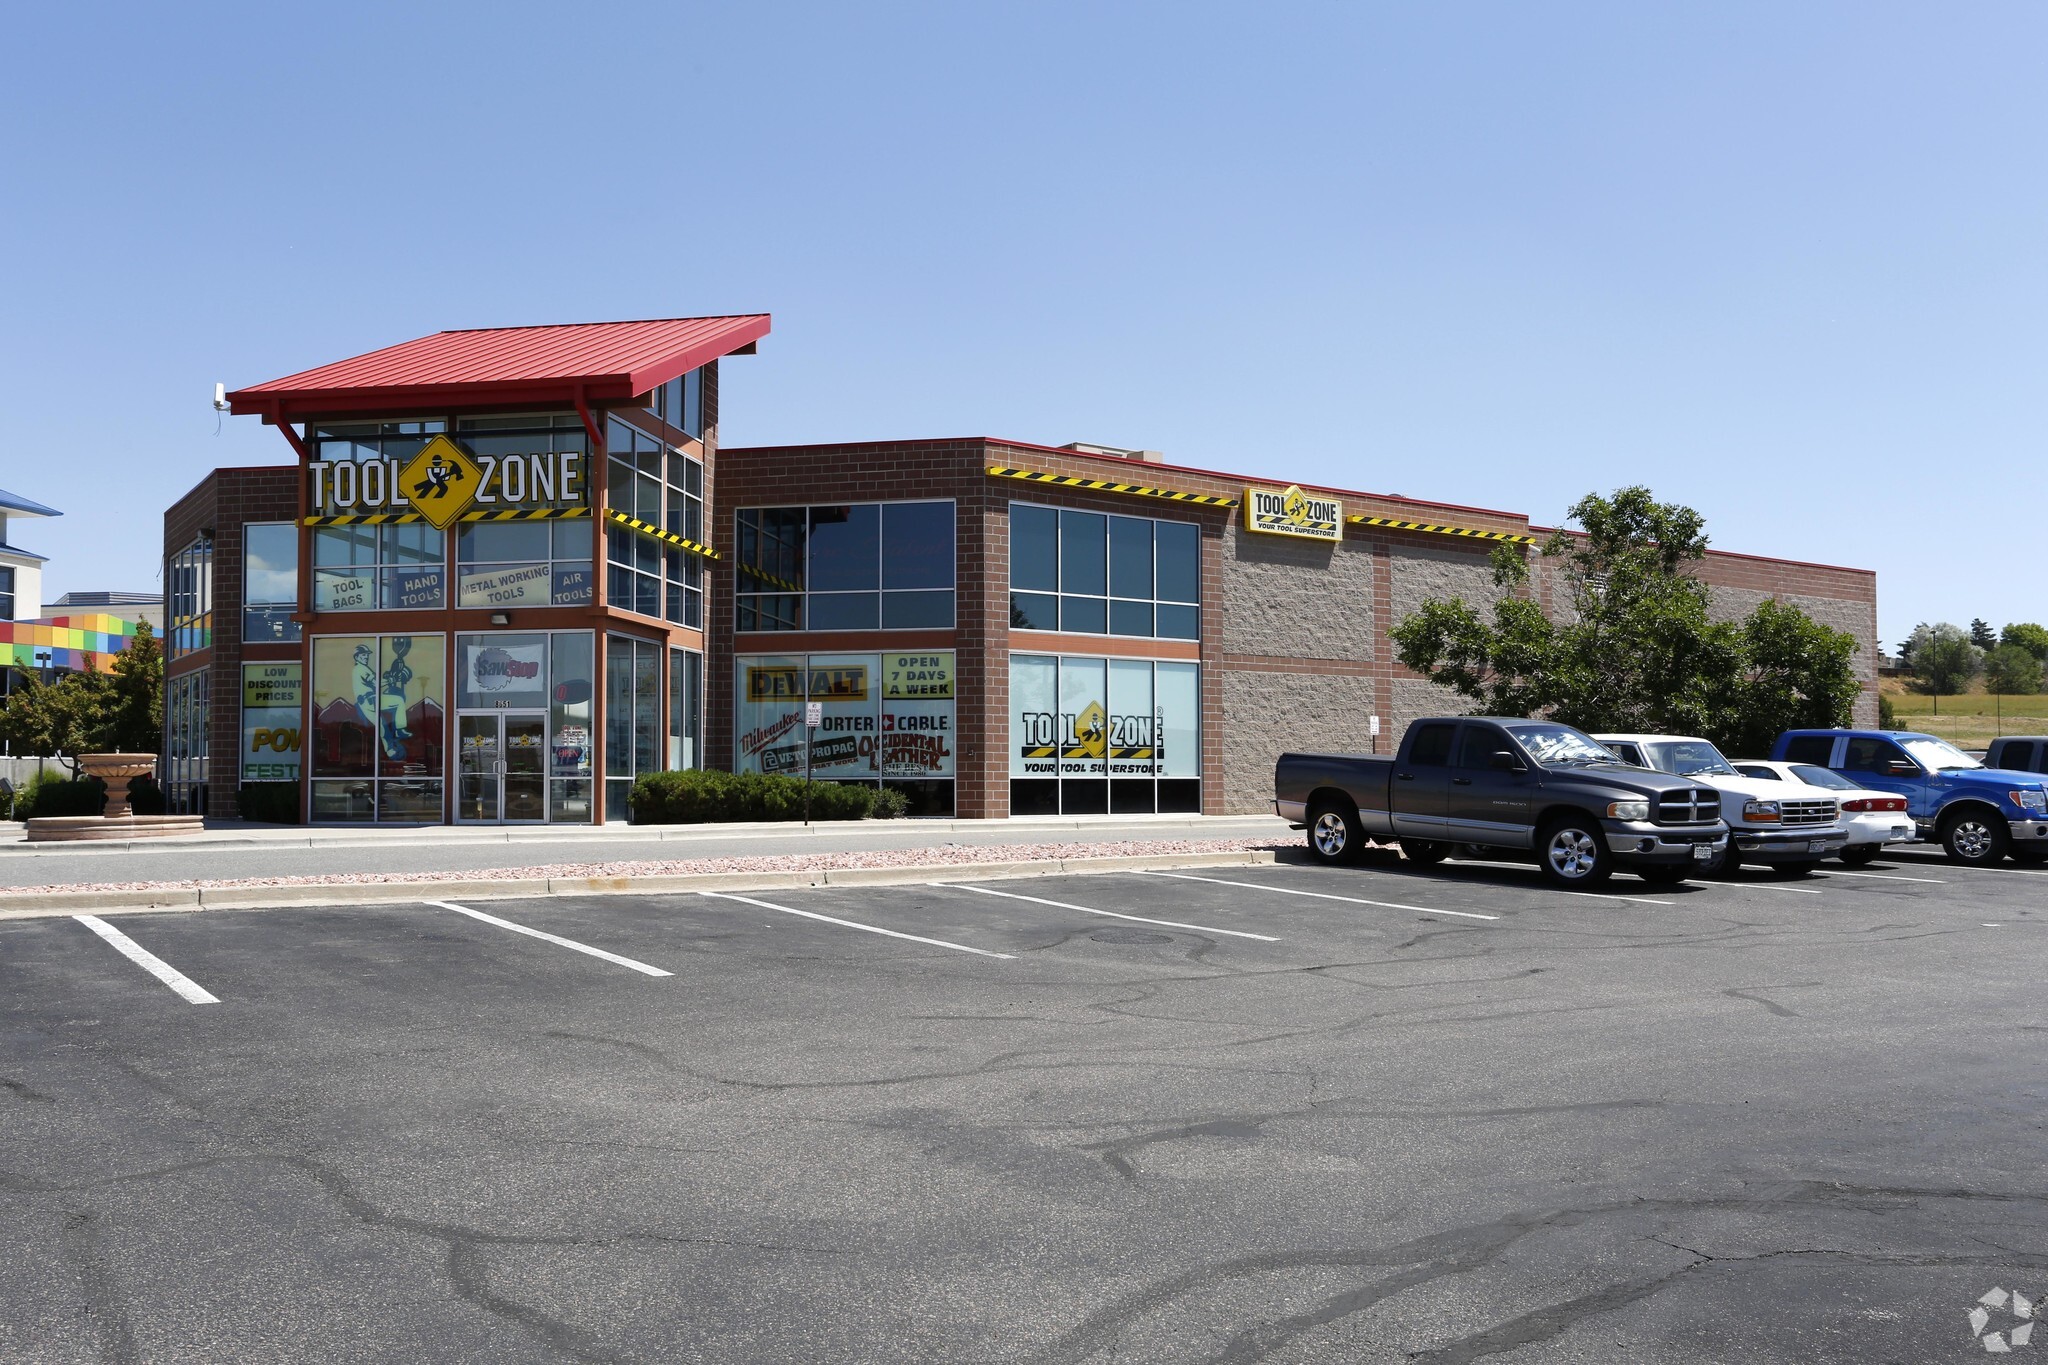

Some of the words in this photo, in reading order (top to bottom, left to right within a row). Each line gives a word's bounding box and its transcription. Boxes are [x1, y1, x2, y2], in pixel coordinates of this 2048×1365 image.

[308, 458, 410, 509] TOOL
[474, 452, 583, 503] ZONE
[1255, 493, 1287, 516] TOOL
[1306, 500, 1336, 522] ZONE
[1294, 527, 1335, 537] SUPERSTORE
[332, 579, 364, 595] TOOL
[404, 574, 438, 592] HAND
[461, 577, 497, 596] METAL
[498, 565, 550, 586] WORKING
[562, 573, 582, 586] AIR
[332, 593, 364, 609] BAGS
[400, 587, 441, 606] TOOLS
[487, 586, 525, 604] TOOLS
[555, 586, 593, 604] TOOLS
[898, 657, 939, 668] OPEN
[264, 668, 288, 677] LOW
[891, 671, 899, 681] 7
[906, 671, 946, 681] DAYS
[248, 680, 302, 689] DISCOUNT
[889, 685, 900, 694] A
[906, 684, 949, 694] WEEK
[255, 692, 294, 701] PRICES
[822, 716, 873, 731] ORTER
[897, 715, 948, 731] CABLE
[1022, 712, 1080, 746] TOOL
[1110, 715, 1164, 748] ZONE
[739, 711, 804, 753] Milwaukee
[778, 749, 807, 763] VETO
[812, 746, 830, 758] PRO
[832, 742, 855, 755] PAC
[858, 733, 950, 757] OCCIDENTAL
[558, 749, 579, 758] OPEN
[834, 757, 859, 766] WORK
[869, 748, 942, 770] LEATHER
[245, 763, 301, 778] FEST
[1024, 763, 1055, 772] YOUR
[1059, 763, 1086, 773] TOOL
[1090, 764, 1163, 774] SUPERSTORE
